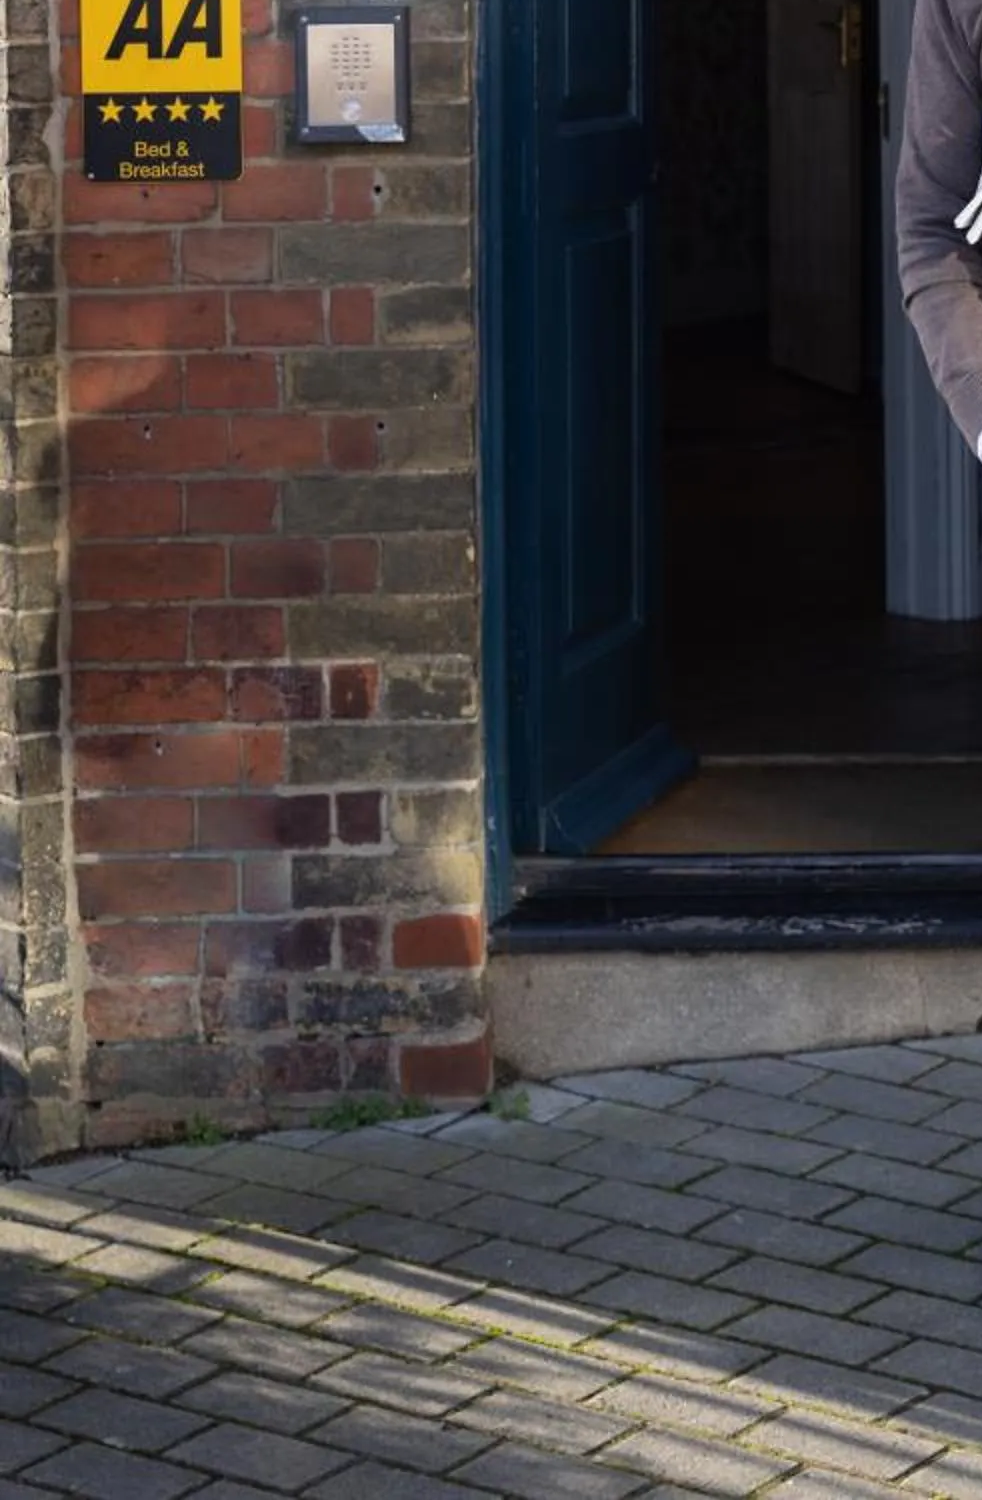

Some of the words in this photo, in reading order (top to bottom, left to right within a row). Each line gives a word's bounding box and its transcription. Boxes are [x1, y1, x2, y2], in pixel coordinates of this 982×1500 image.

[134, 140, 171, 158] Bed
[176, 140, 189, 158] &
[119, 161, 205, 179] Breakfast
